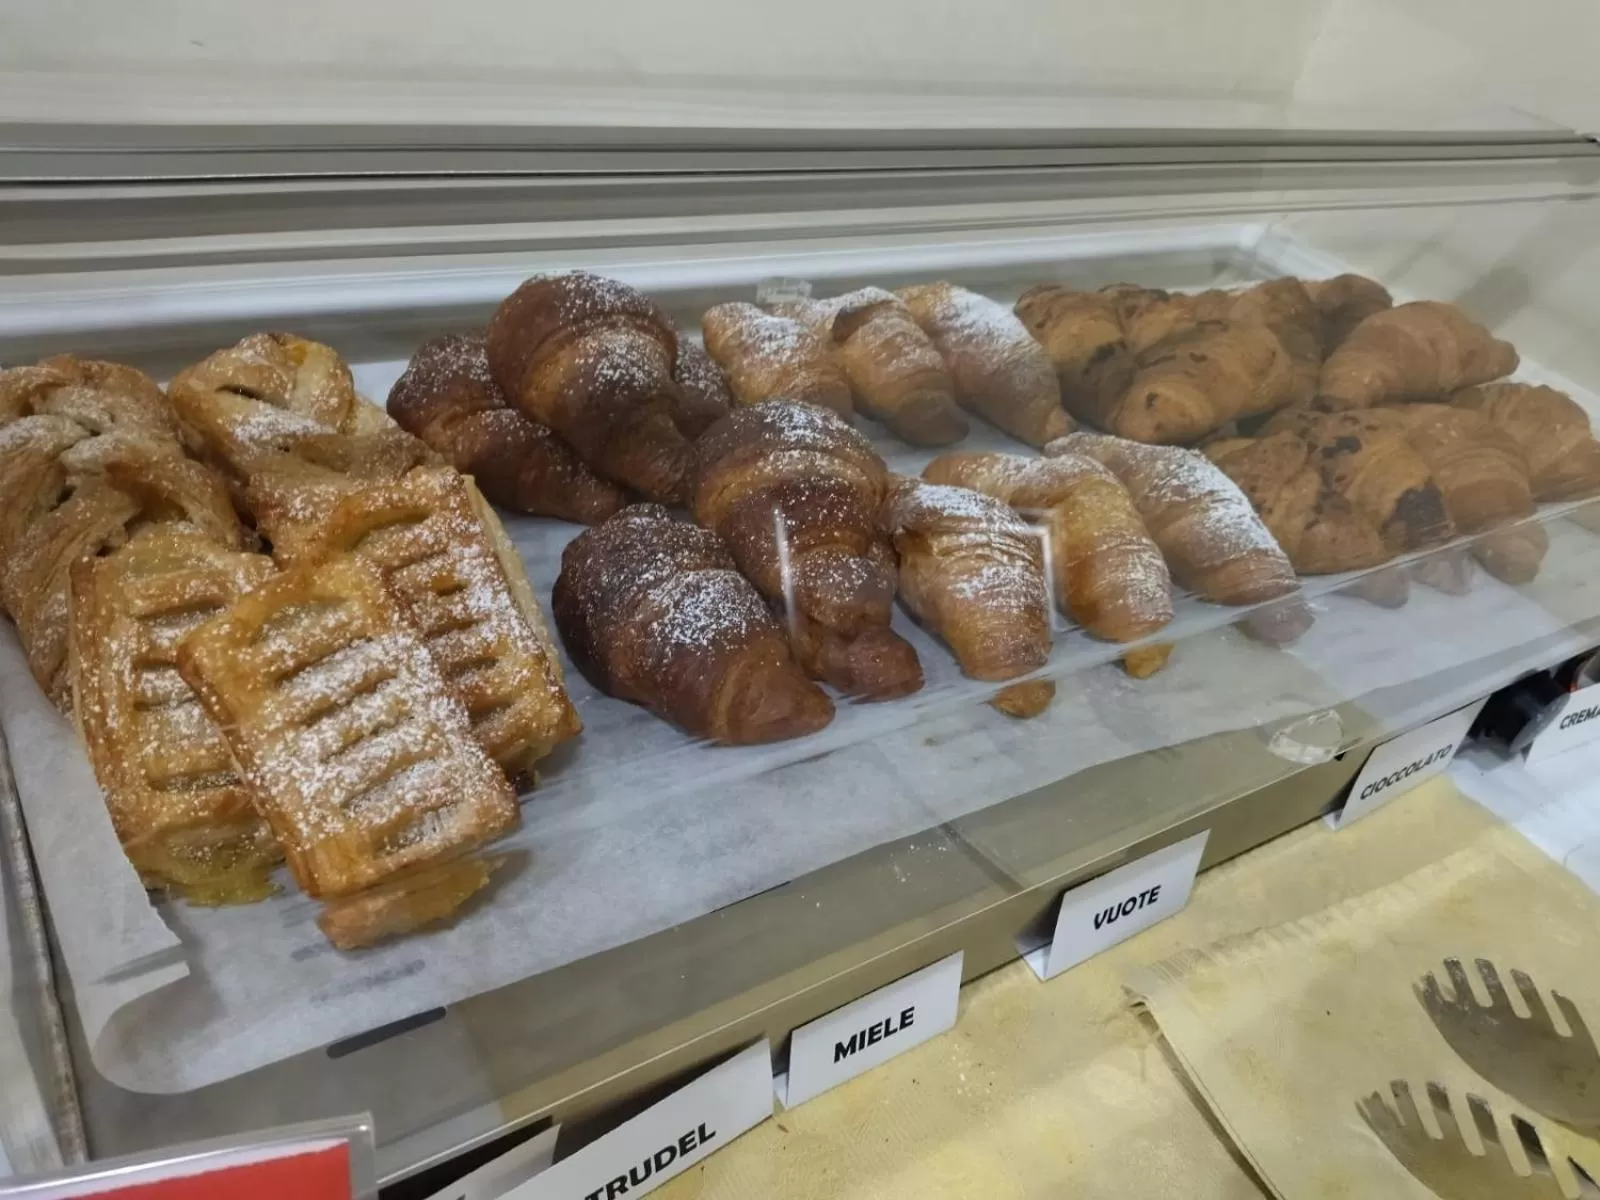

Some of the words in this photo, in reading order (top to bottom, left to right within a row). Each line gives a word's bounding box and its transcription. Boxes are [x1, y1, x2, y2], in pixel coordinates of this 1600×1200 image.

[1360, 743, 1453, 801] CIOCCOLATO
[1093, 884, 1162, 930] VUOTE
[833, 1005, 915, 1064] MIELE
